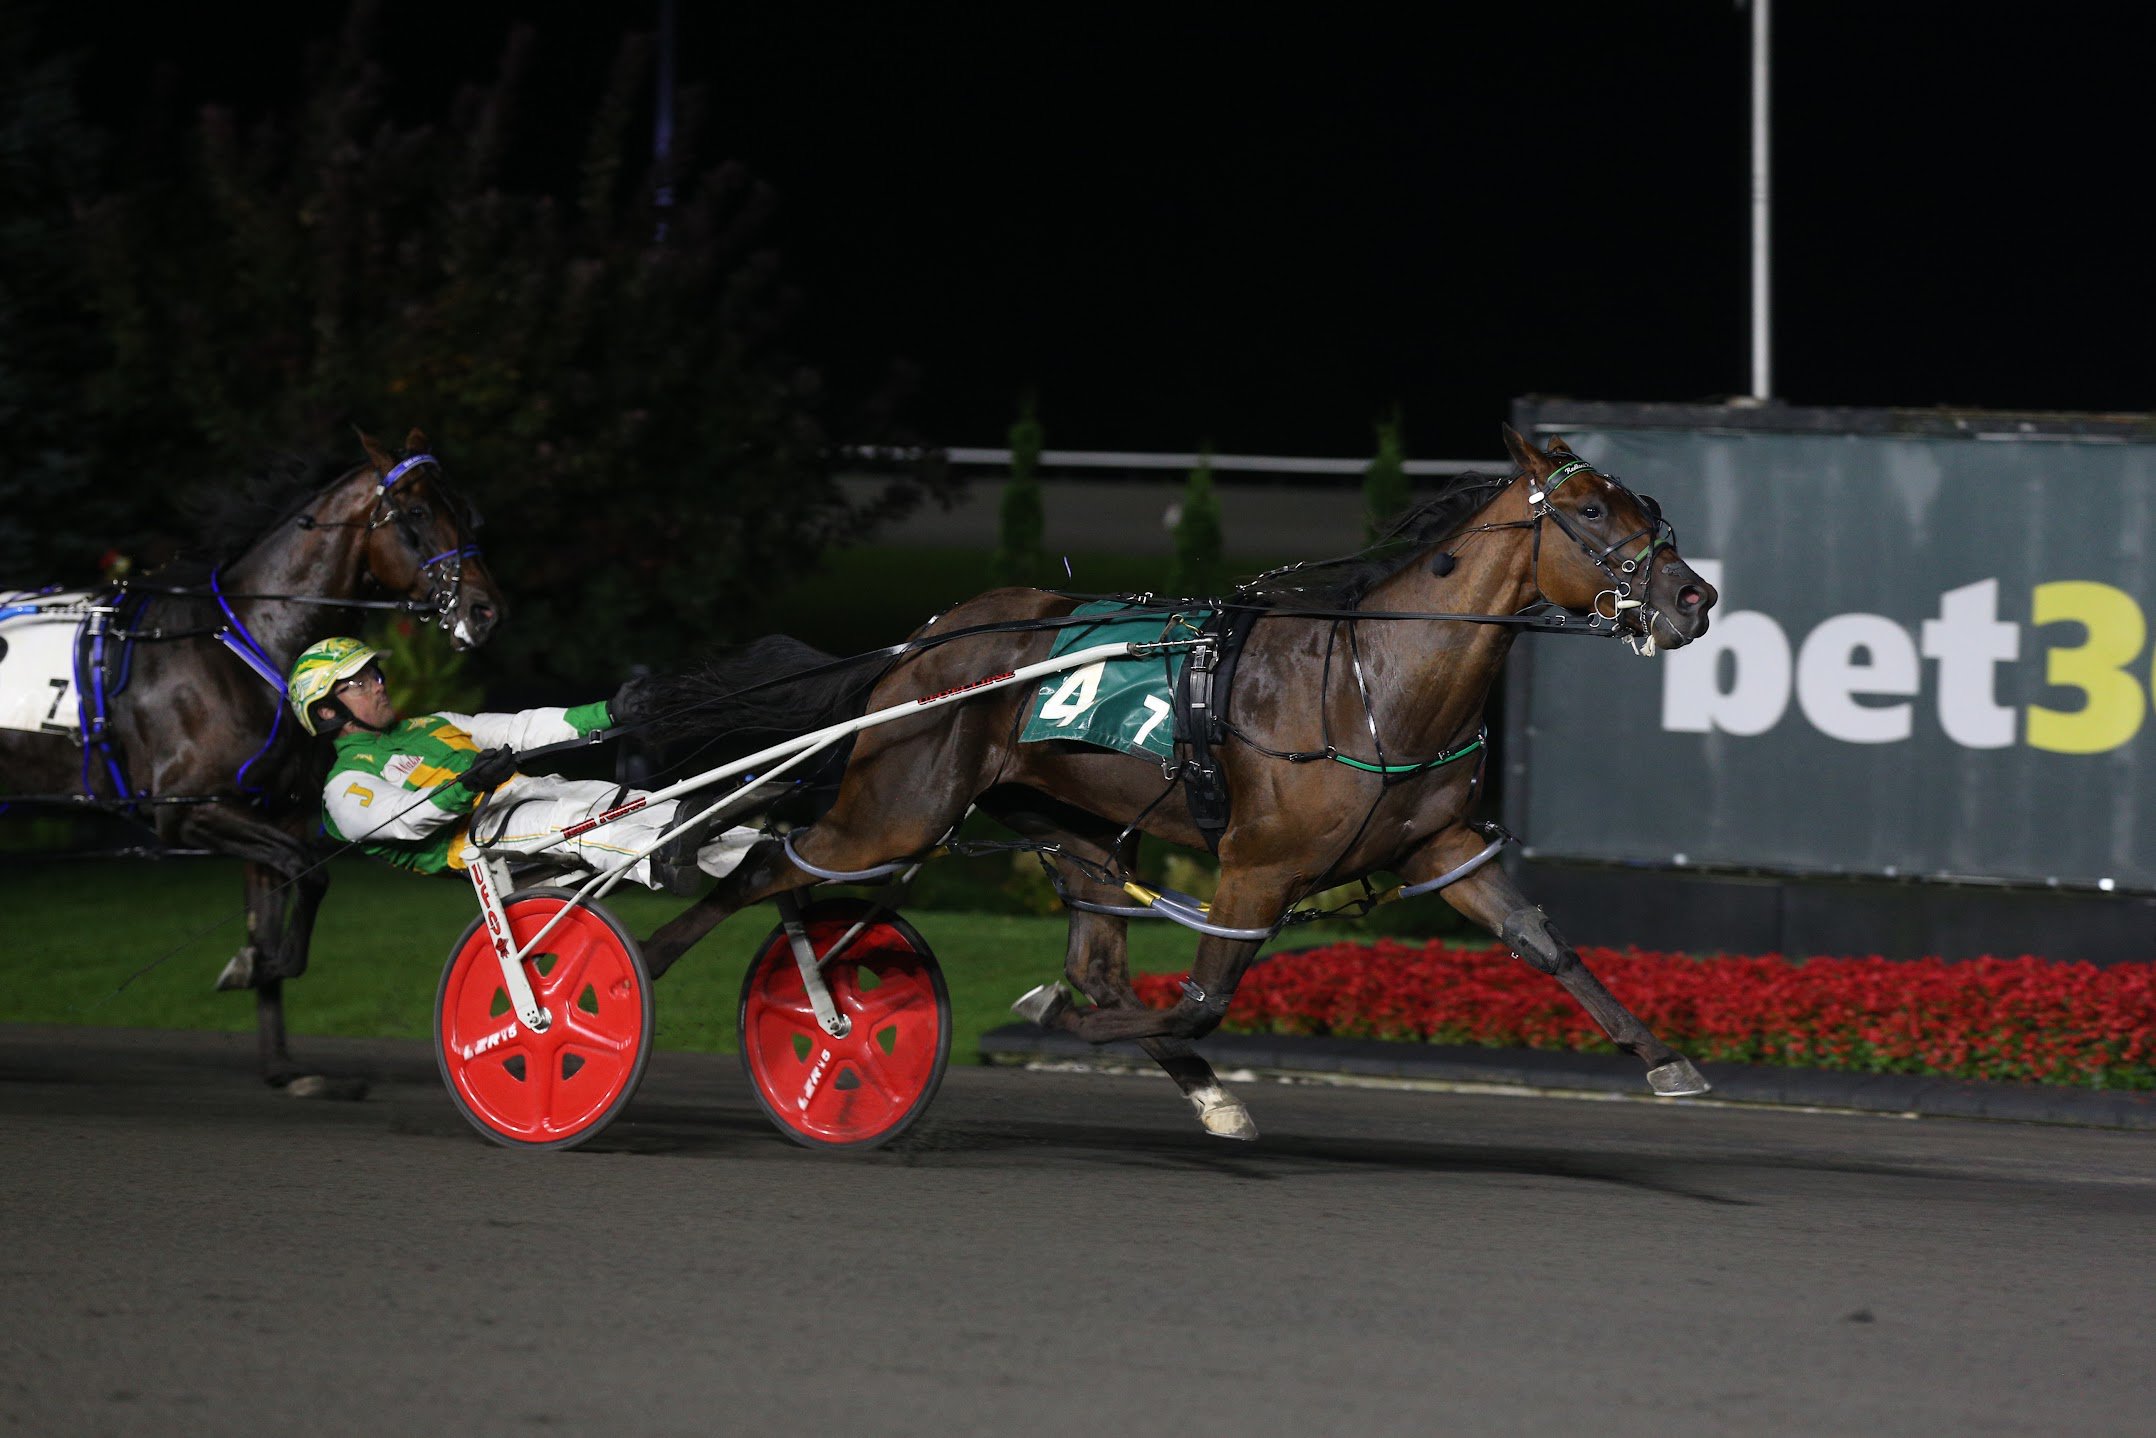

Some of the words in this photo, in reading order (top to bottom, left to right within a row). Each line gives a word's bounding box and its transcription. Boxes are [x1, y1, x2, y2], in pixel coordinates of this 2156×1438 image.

[1661, 558, 2156, 755] bet3
[48, 678, 70, 720] 7
[1039, 659, 1107, 728] 4
[1132, 694, 1171, 746] 7
[343, 782, 375, 809] J
[471, 862, 502, 936] UFO
